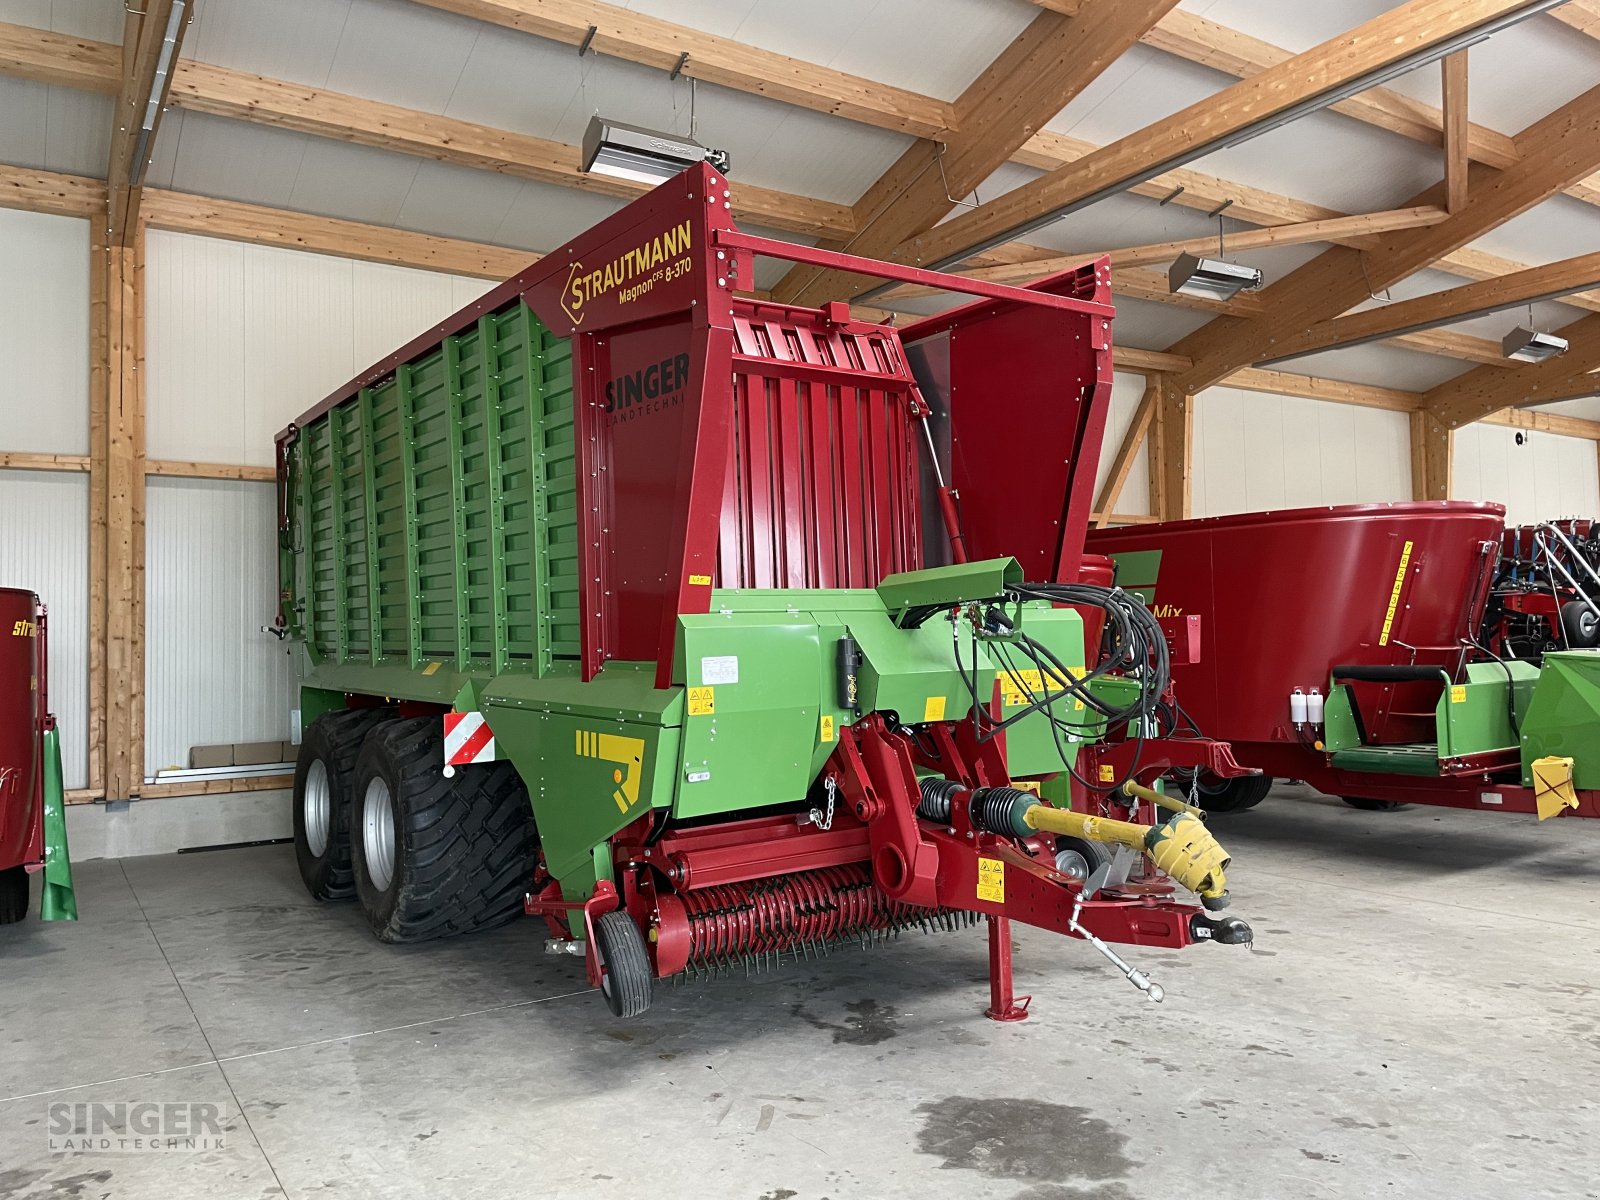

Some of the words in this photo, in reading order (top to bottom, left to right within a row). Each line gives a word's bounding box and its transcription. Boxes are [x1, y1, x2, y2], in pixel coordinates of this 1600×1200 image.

[571, 220, 691, 310] STRAUTMANN
[665, 257, 692, 282] 8-370
[605, 353, 689, 413] SINGER
[1153, 604, 1183, 618] Mix
